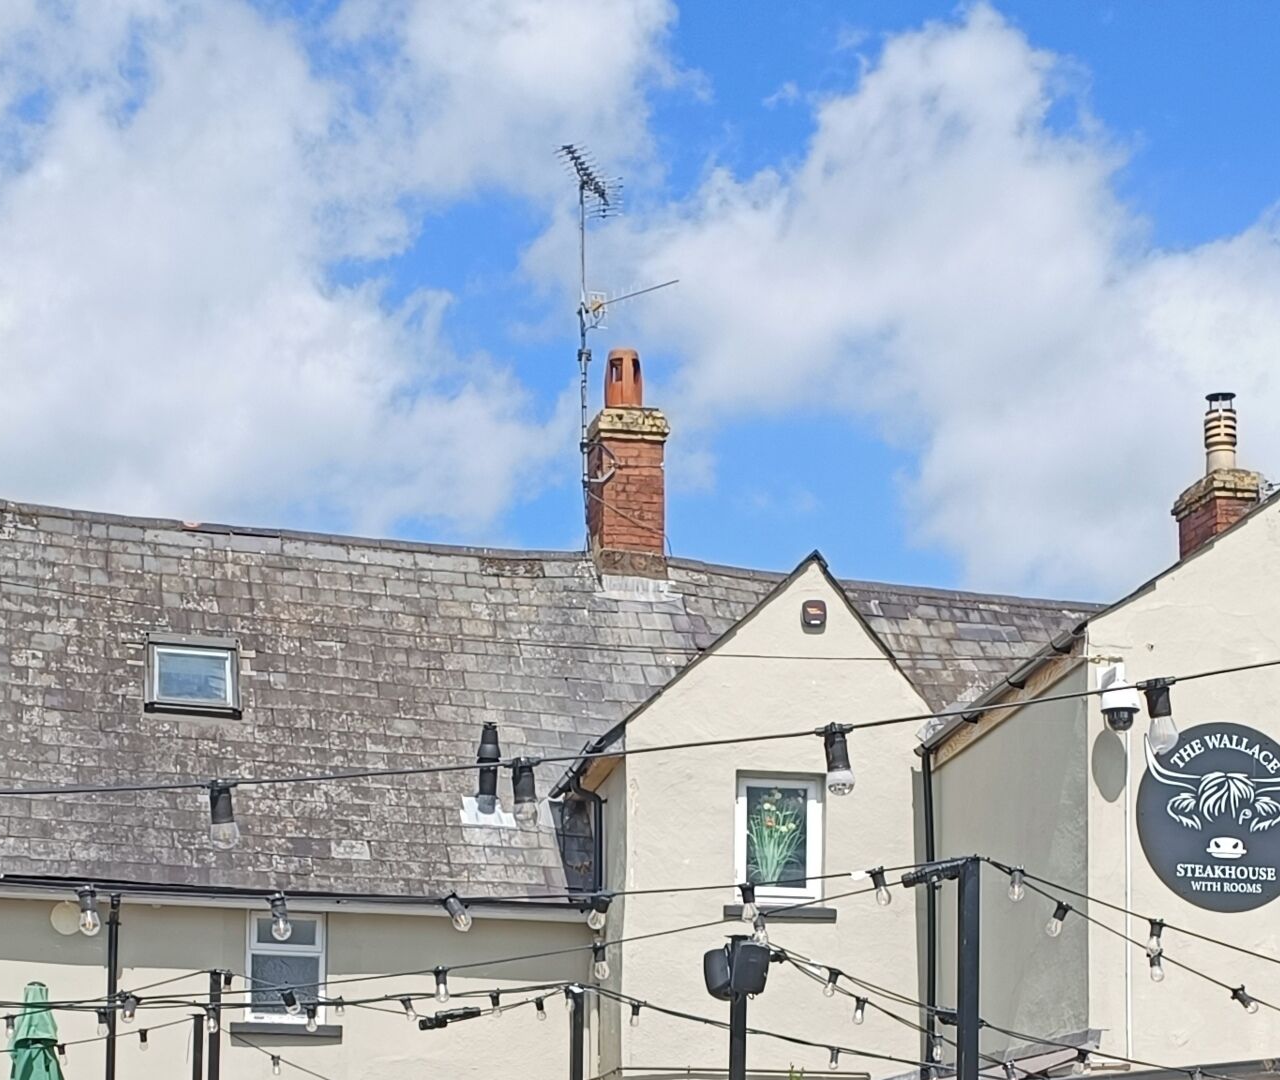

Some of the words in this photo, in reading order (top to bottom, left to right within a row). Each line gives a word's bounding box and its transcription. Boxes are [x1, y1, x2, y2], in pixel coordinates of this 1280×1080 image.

[1170, 739, 1205, 769] THE
[1204, 733, 1280, 775] WALLACE
[1176, 863, 1276, 881] STEAKHOUSE
[1191, 880, 1221, 892] WITH
[1223, 881, 1262, 894] ROOMS
